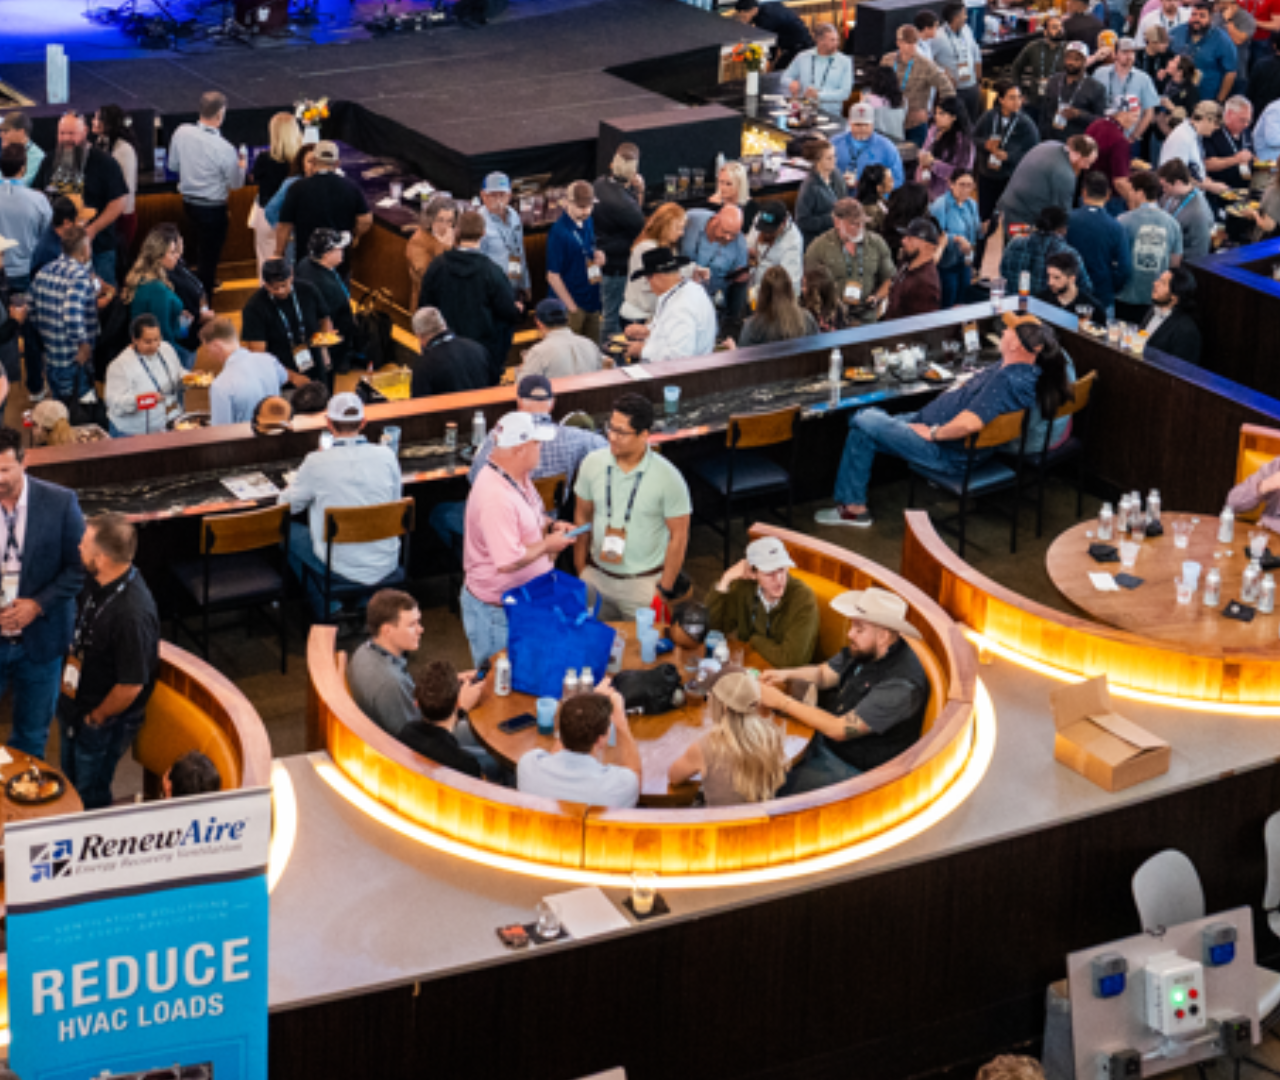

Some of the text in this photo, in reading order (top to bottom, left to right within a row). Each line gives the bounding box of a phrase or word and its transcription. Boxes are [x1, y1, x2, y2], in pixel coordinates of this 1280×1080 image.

[79, 816, 246, 863] RenewAire
[31, 936, 251, 1016] REDUCE
[57, 993, 225, 1042] HVAC LOADS
